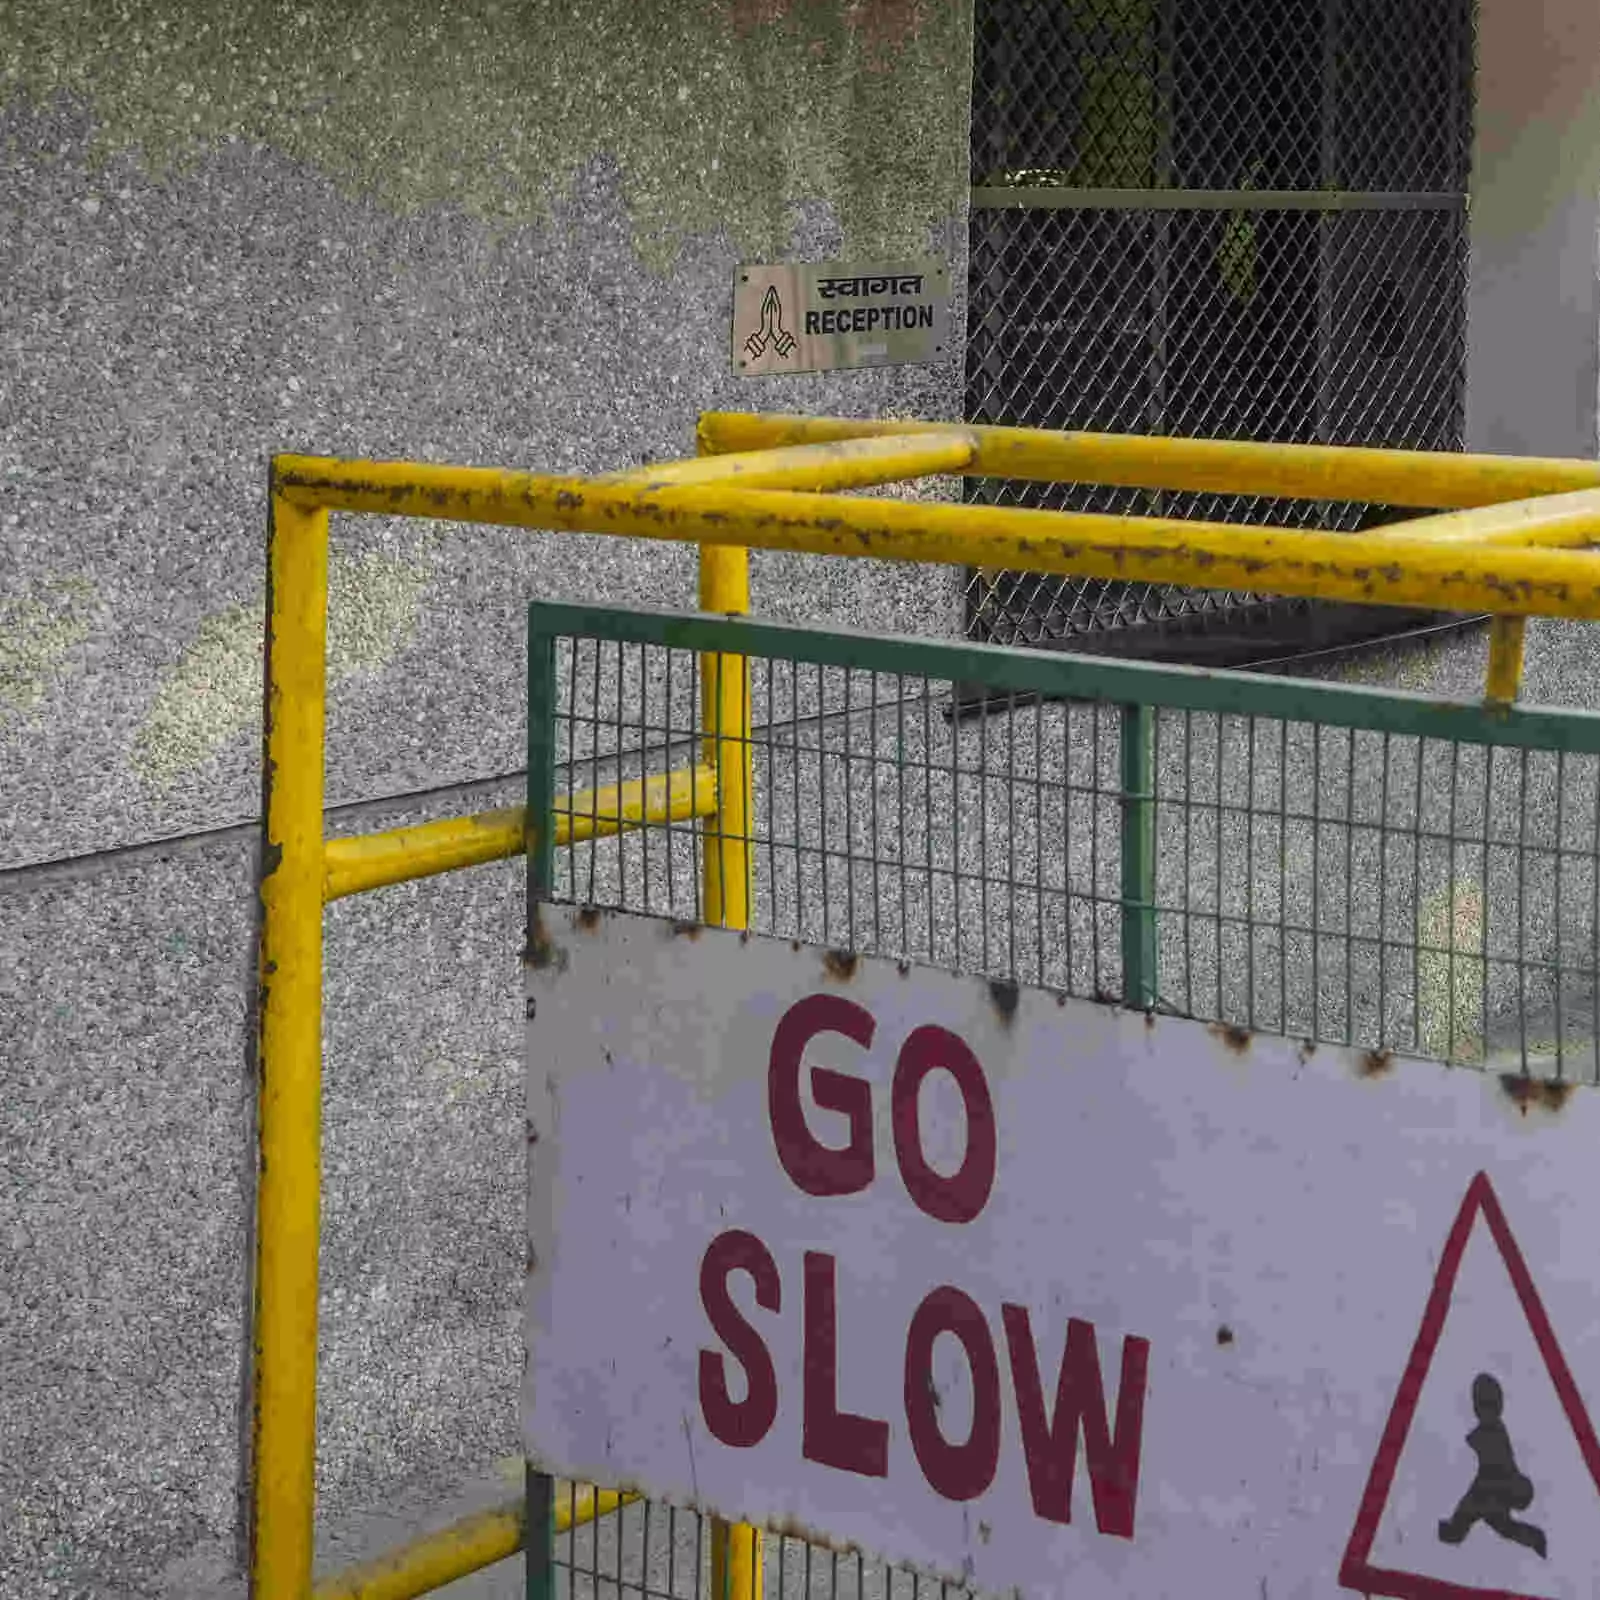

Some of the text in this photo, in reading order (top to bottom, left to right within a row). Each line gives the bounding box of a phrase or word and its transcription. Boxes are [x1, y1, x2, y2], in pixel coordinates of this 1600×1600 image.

[805, 304, 934, 335] RECEPTION
[817, 275, 924, 299] स्वागत
[768, 993, 996, 1224] GO
[700, 1229, 1150, 1539] SLOW
